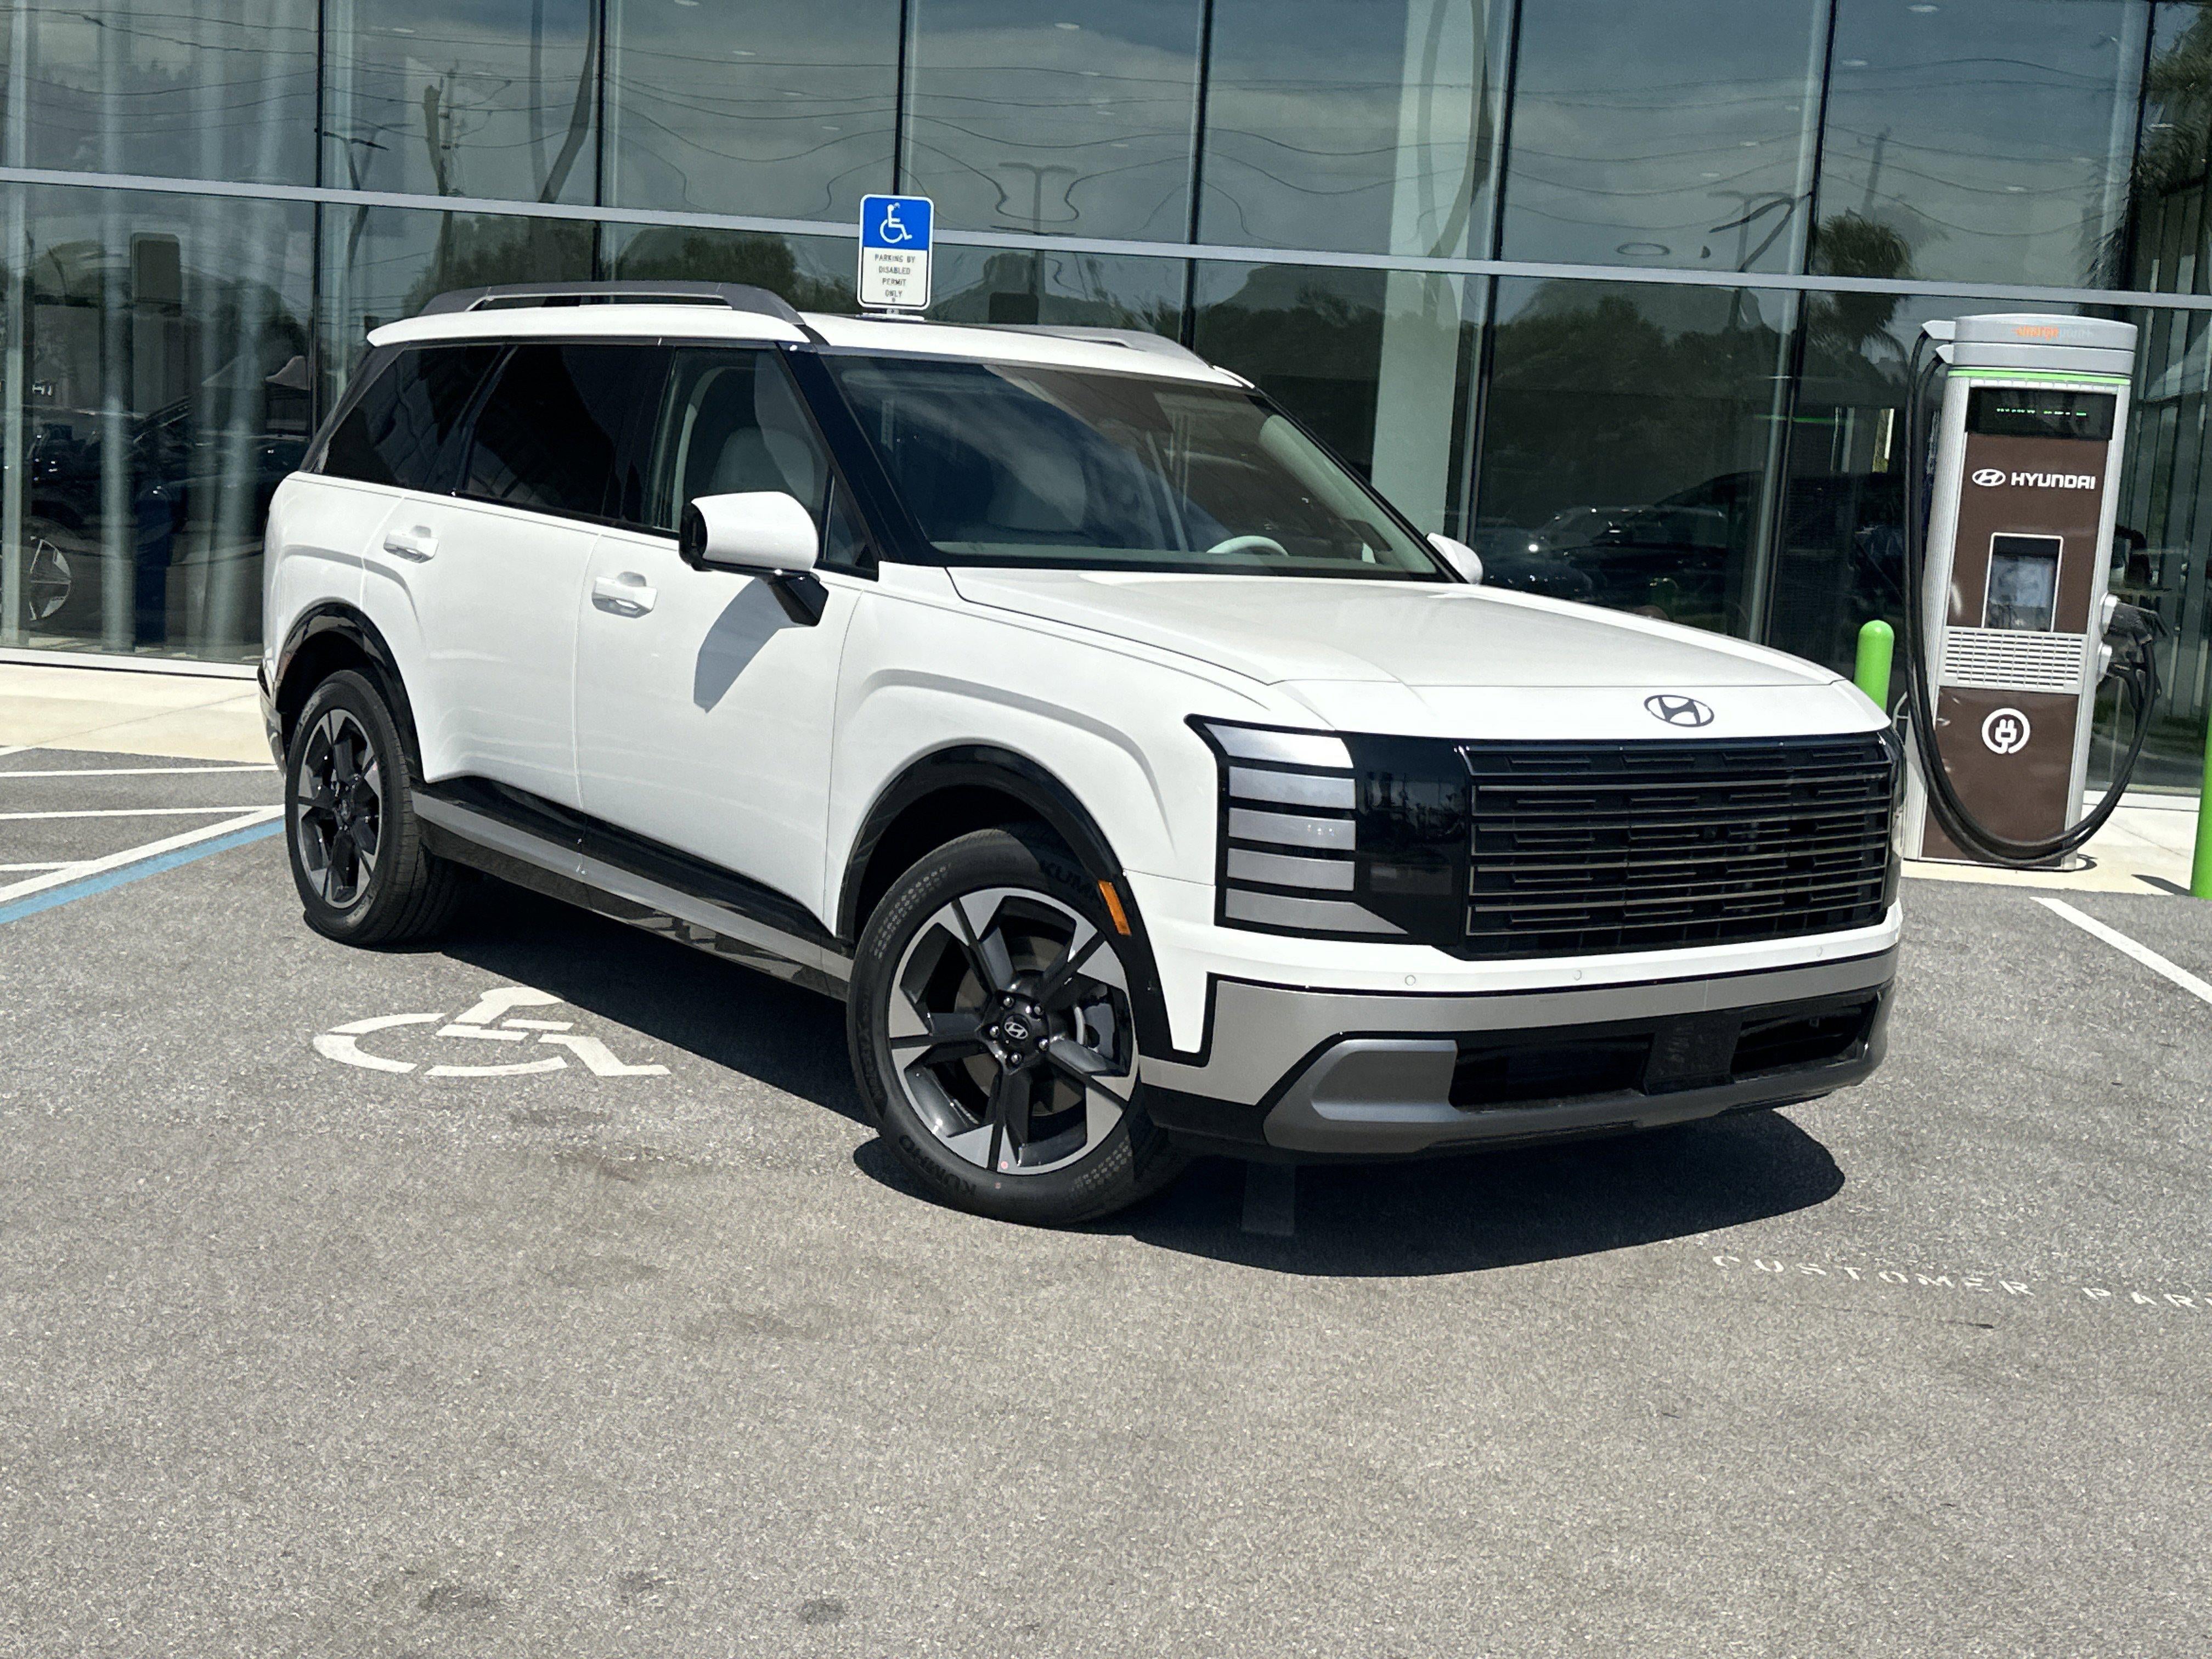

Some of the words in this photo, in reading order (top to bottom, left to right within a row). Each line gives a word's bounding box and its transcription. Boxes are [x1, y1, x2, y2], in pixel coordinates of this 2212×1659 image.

[875, 254, 903, 262] PARKING
[879, 266, 911, 274] DISABLED
[882, 278, 906, 286] PERMIT
[885, 289, 902, 297] ONLY
[2011, 472, 2096, 489] HYUNDAI
[1713, 1255, 2035, 1296] CUSTOMER
[2082, 1288, 2212, 1308] PAR
